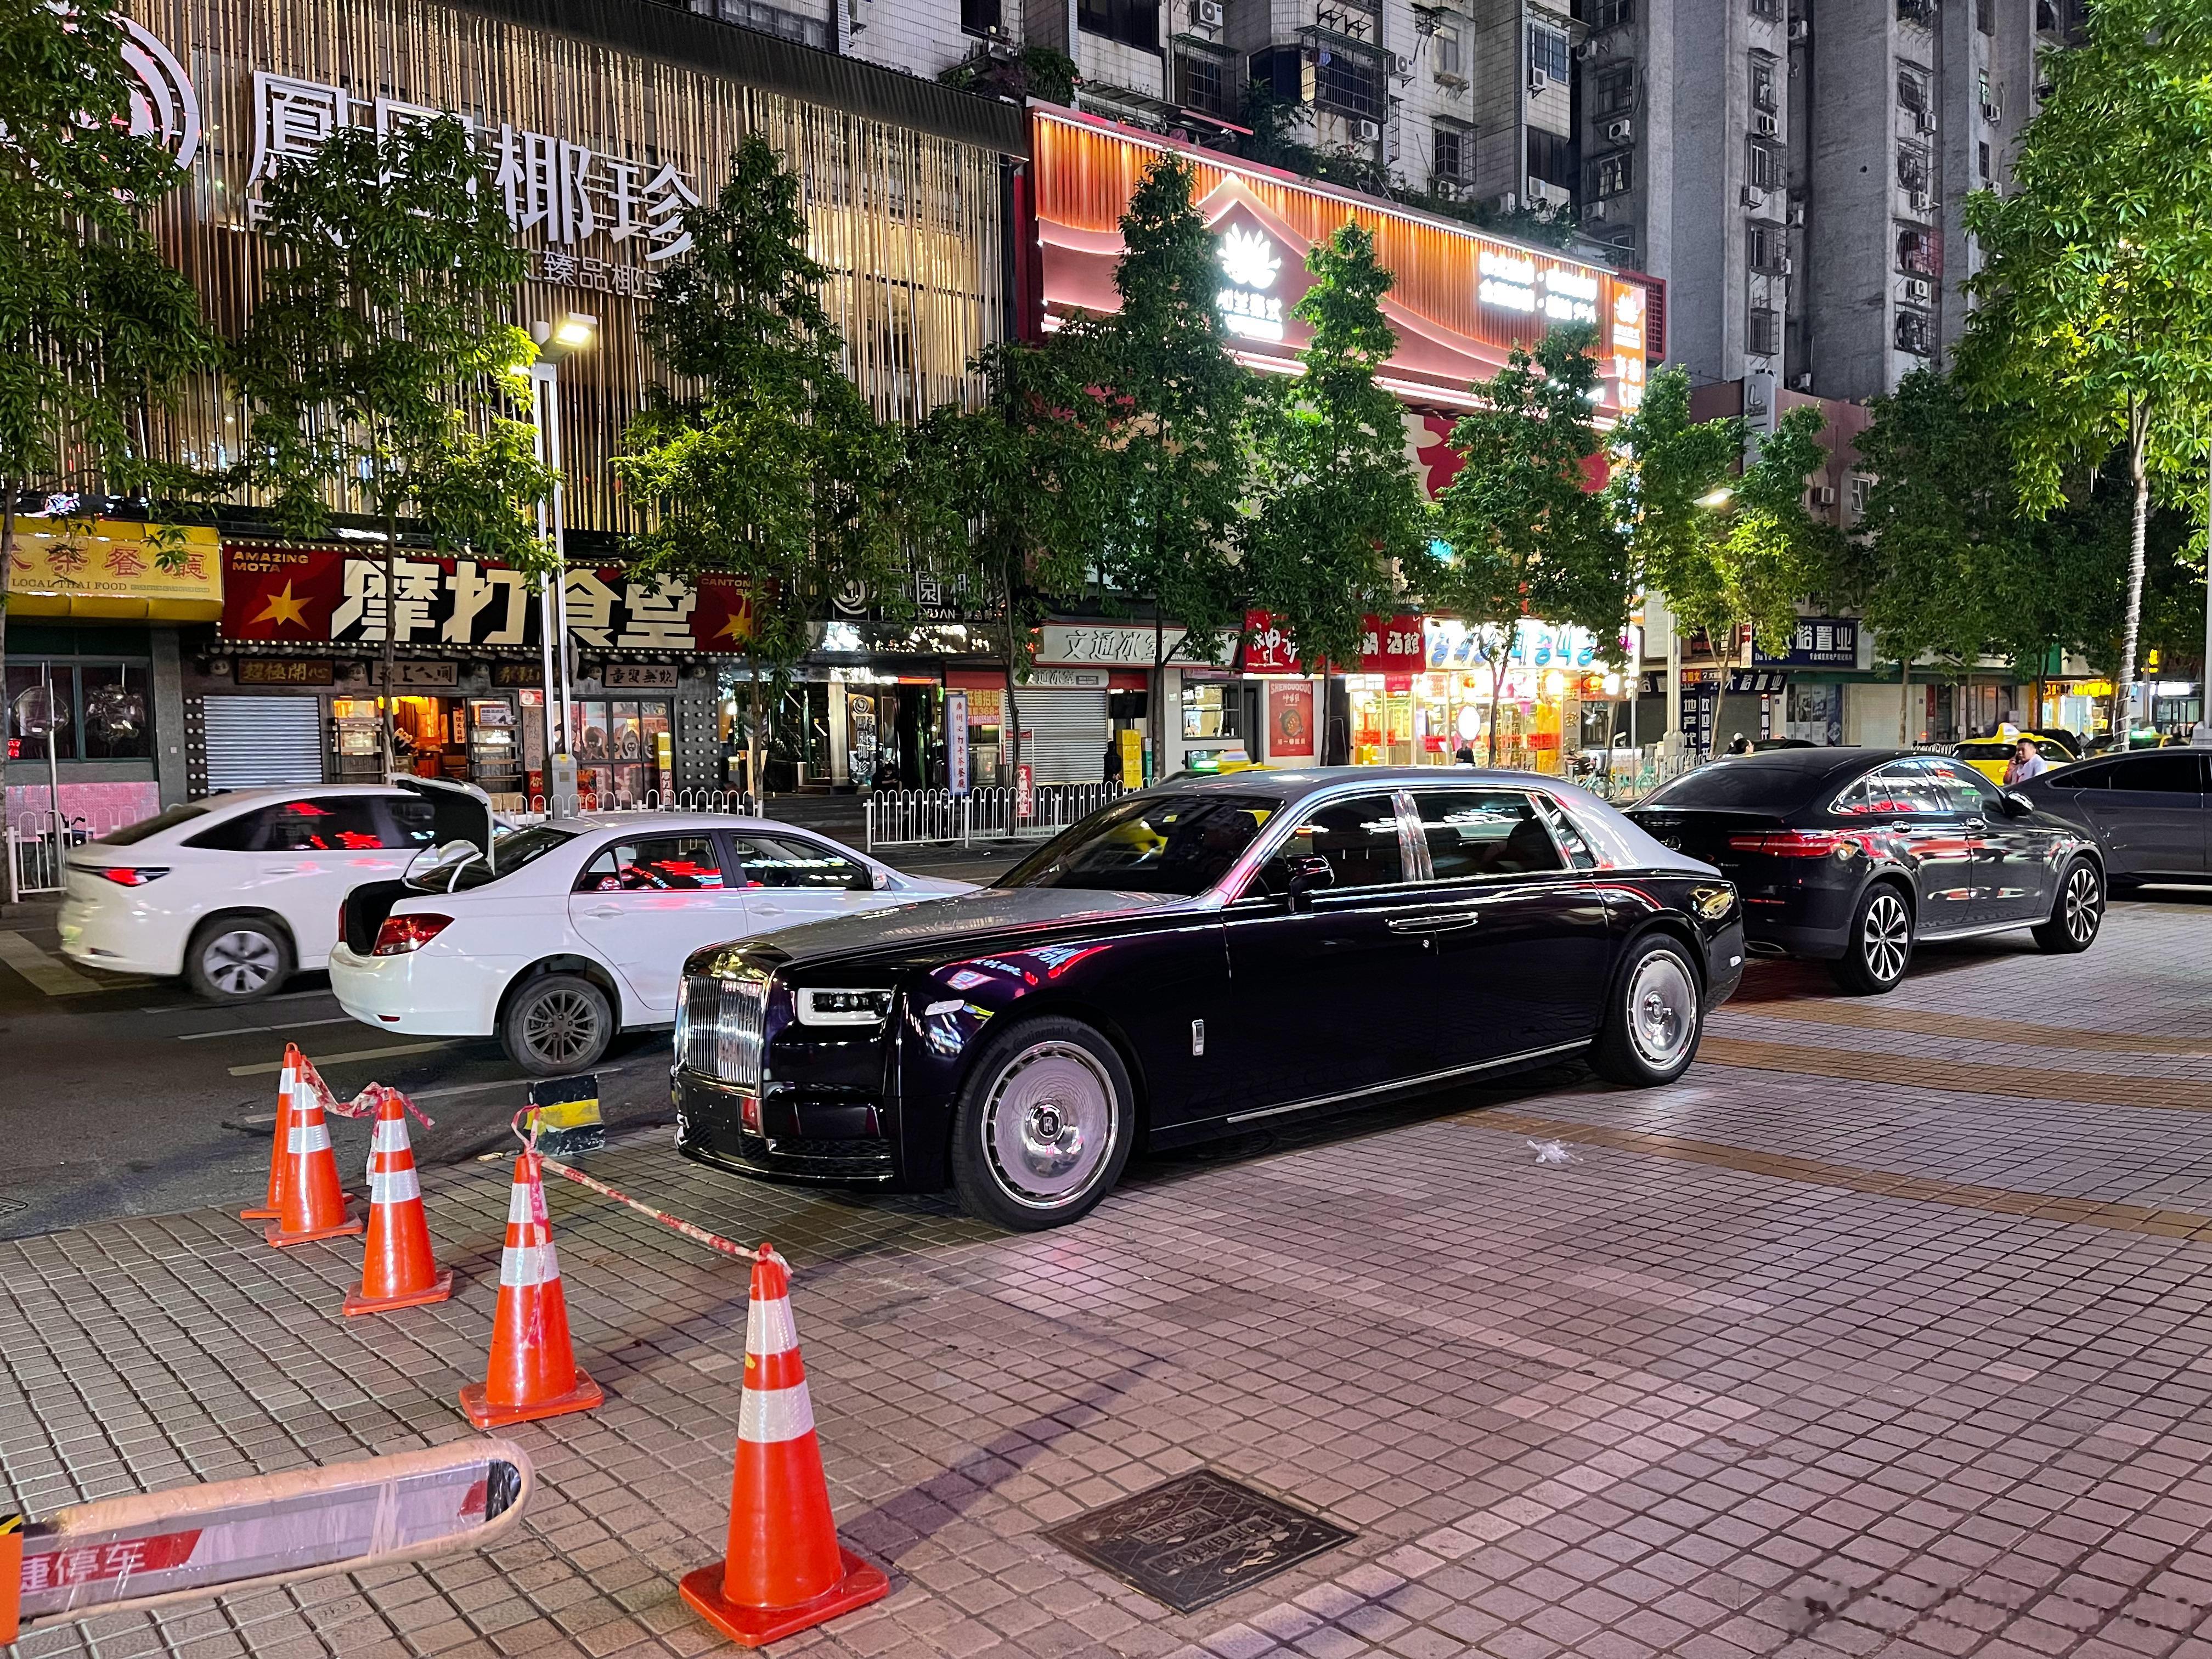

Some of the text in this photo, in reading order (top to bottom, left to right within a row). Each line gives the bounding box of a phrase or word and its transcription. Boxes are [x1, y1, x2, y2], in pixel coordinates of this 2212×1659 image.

[543, 251, 663, 296] 臻品椰
[233, 551, 308, 564] AMAZING
[233, 562, 281, 573] MOTA
[12, 578, 54, 588] LOCAL
[94, 582, 127, 590] FOOD
[331, 557, 696, 649] 摩打食堂
